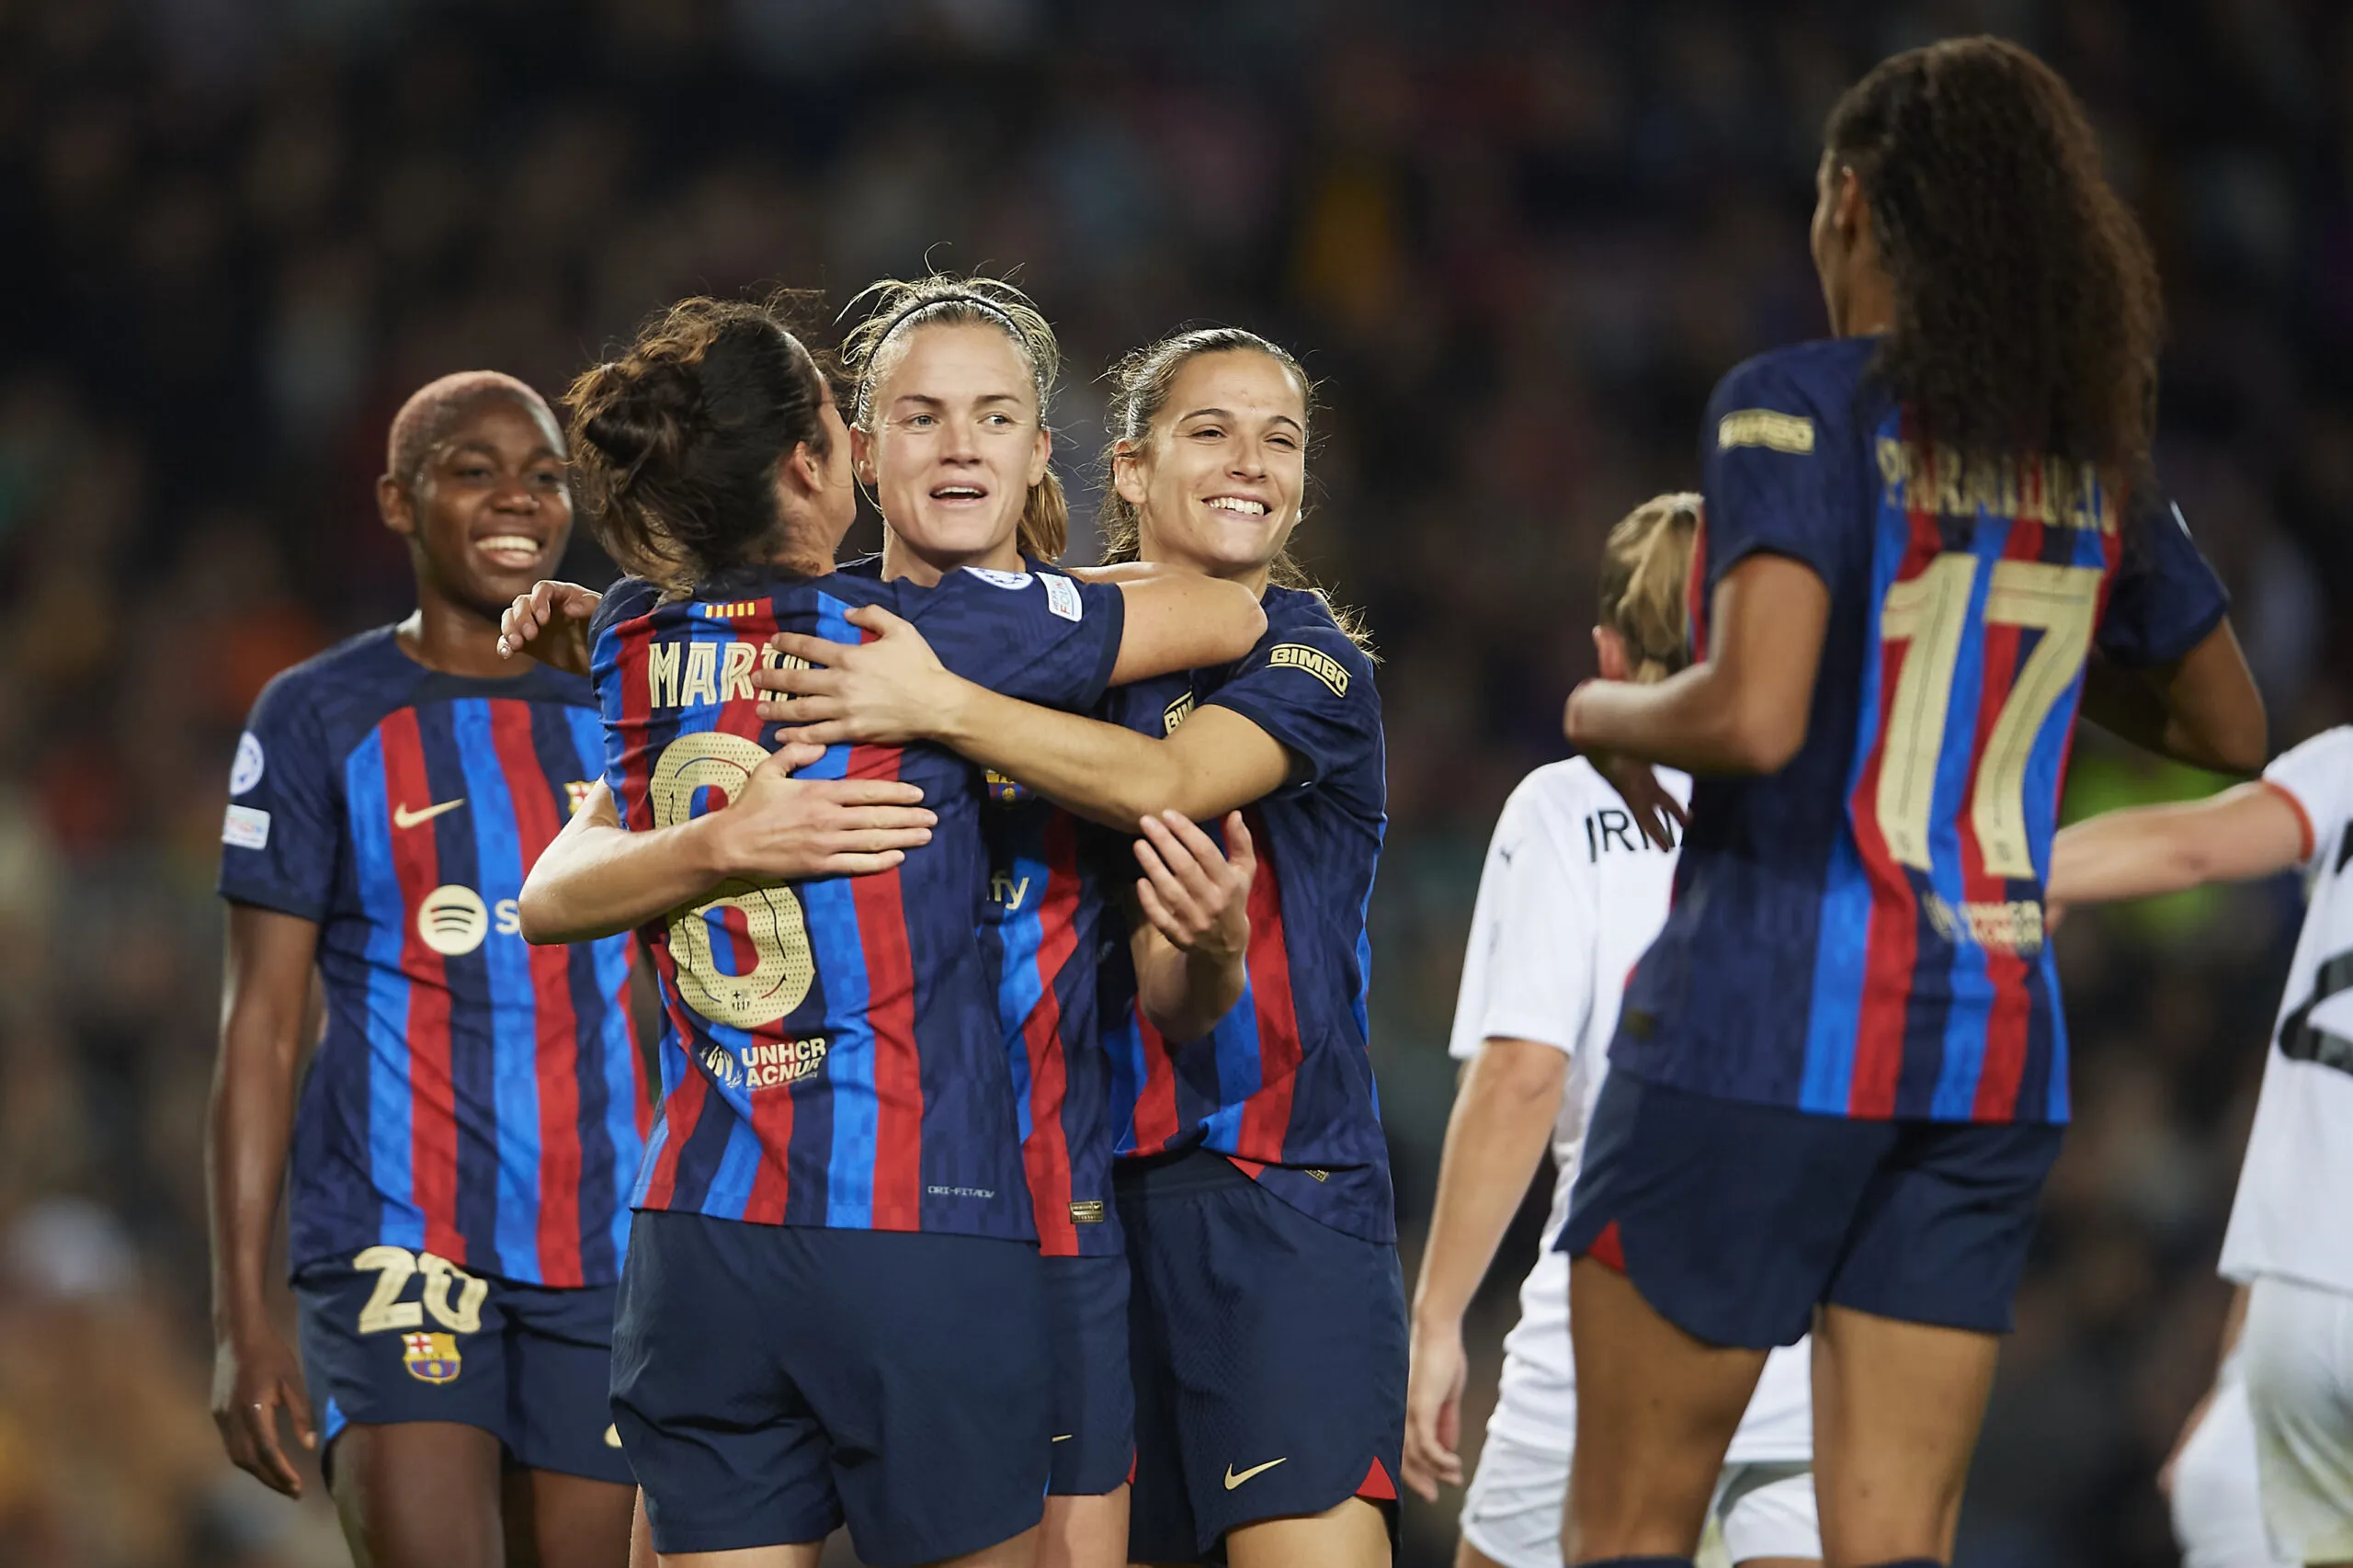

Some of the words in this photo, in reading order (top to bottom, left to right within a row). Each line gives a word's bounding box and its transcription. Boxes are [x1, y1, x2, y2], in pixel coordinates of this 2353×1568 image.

[1270, 648, 1348, 693] BIMBO
[1876, 552, 2105, 879] 17
[741, 1037, 827, 1068] UNHCR
[745, 1057, 823, 1087] ACNUR
[352, 1244, 488, 1334] 20
